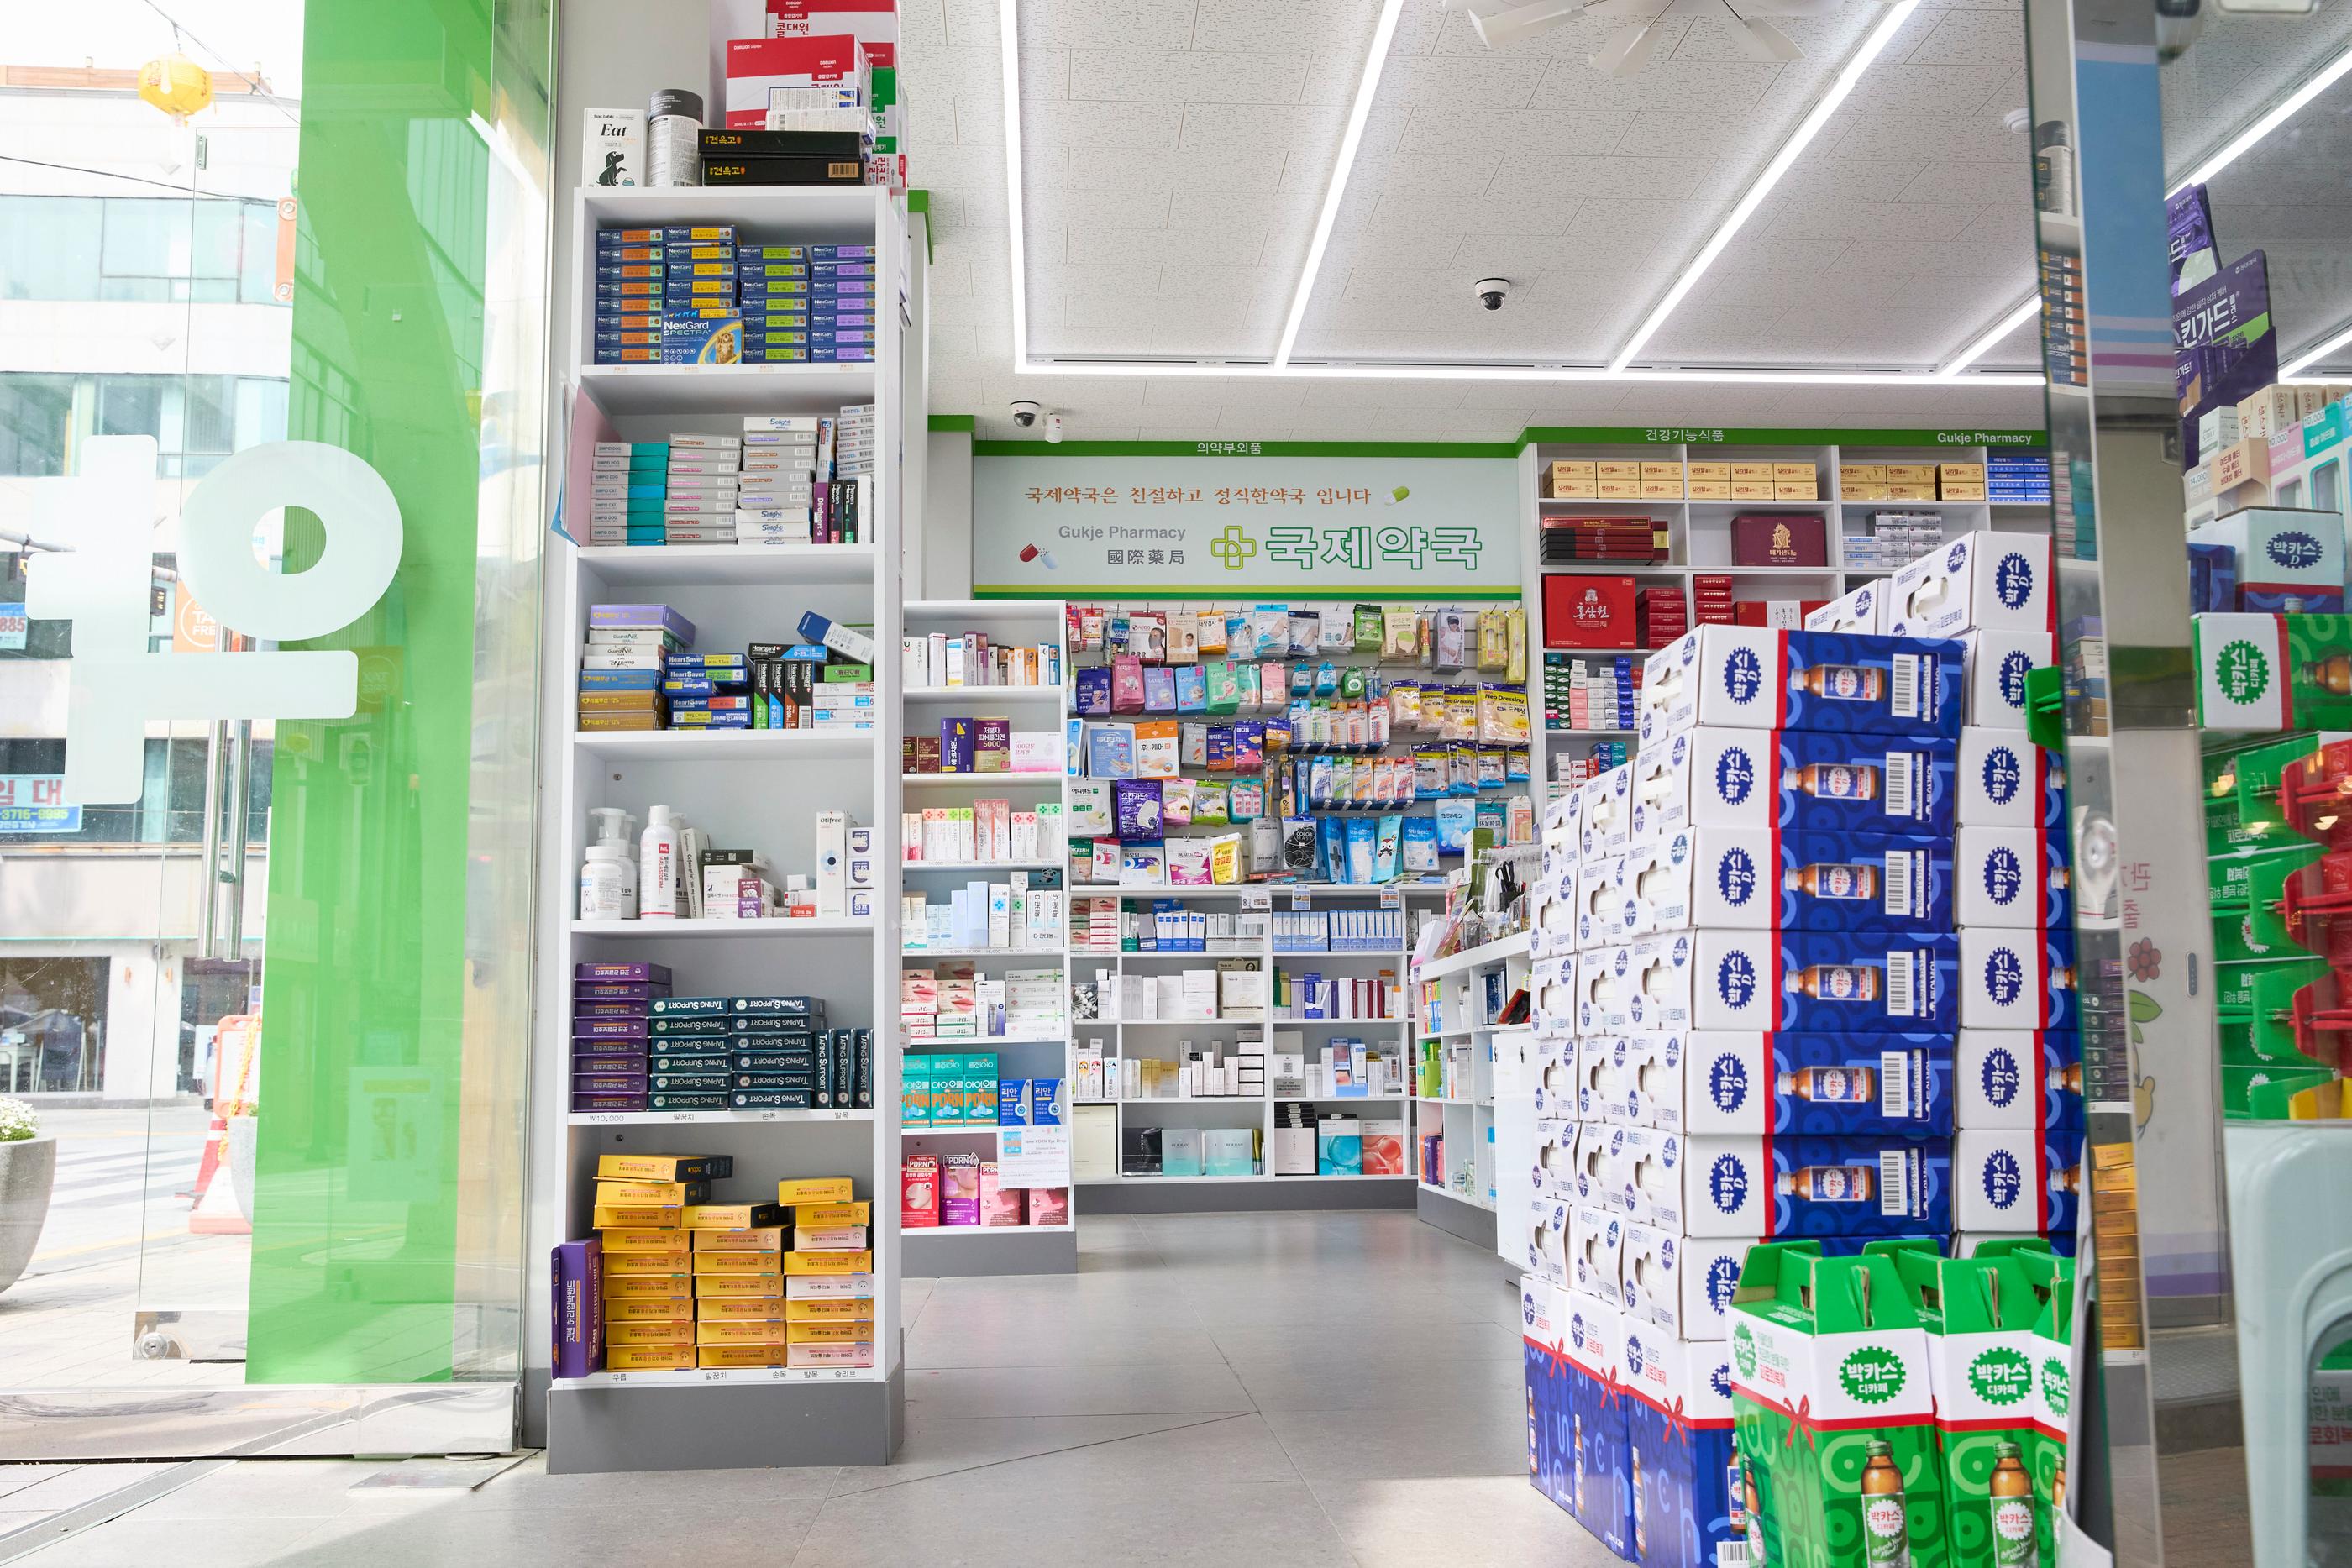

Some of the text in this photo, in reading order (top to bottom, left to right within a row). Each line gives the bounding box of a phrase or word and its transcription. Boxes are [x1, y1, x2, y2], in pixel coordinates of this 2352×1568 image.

[775, 23, 809, 38] 콜대원
[601, 123, 627, 137] Eat
[664, 322, 709, 330] NexGard
[1646, 428, 1725, 442] 건강기능식품
[1937, 433, 2033, 444] Gukje Pharmacy
[1196, 442, 1263, 454] 의약부외품
[1025, 485, 1372, 506] 국제약국은 친절하고 정직한약국 입니다
[1058, 525, 1186, 542] Gukje Pharmacy
[1265, 526, 1483, 571] 국제약국
[2273, 541, 2317, 556] 박카스
[1107, 548, 1185, 565] 國際藥局
[2290, 554, 2301, 565] D
[2005, 559, 2020, 603] 박카스
[2019, 576, 2029, 588] D
[192, 611, 216, 623] TA
[1573, 601, 1610, 620] 홍삼원
[1733, 653, 1749, 699] 박카스
[1746, 669, 1759, 682] D
[2231, 648, 2248, 697] 박카스
[2250, 658, 2260, 688] 디카페
[1498, 695, 1525, 705] Dressing
[1725, 753, 1740, 799] 박카스
[1739, 770, 1751, 782] D
[1992, 753, 2007, 798] 박카스
[2006, 770, 2017, 781] D
[1728, 853, 1742, 900] 박카스
[1740, 871, 1752, 884] D
[1993, 852, 2008, 899] 박카스
[2007, 870, 2018, 882] D
[1728, 957, 1743, 1004] 박카스
[1741, 974, 1753, 986] D
[1994, 953, 2009, 1000] 박카스
[2008, 971, 2019, 983] D
[1719, 1059, 1735, 1107] 박카스
[1733, 1077, 1745, 1088] D
[1991, 1054, 2006, 1101] 박카스
[2004, 1072, 2016, 1083] D
[1035, 1087, 1053, 1095] 리안
[932, 1093, 963, 1108] PDRN
[965, 1093, 997, 1108] PDRN
[1719, 1160, 1735, 1208] 박카스
[1733, 1177, 1745, 1189] D
[1992, 1156, 2008, 1203] 박카스
[2006, 1173, 2017, 1185] D
[1845, 1362, 1898, 1382] 박카스
[1975, 1362, 2028, 1382] 박카스
[1858, 1384, 1888, 1394] 디카페
[1987, 1384, 2018, 1395] 디카페
[1870, 1511, 1900, 1522] 박카스
[1999, 1513, 2029, 1524] 박카스
